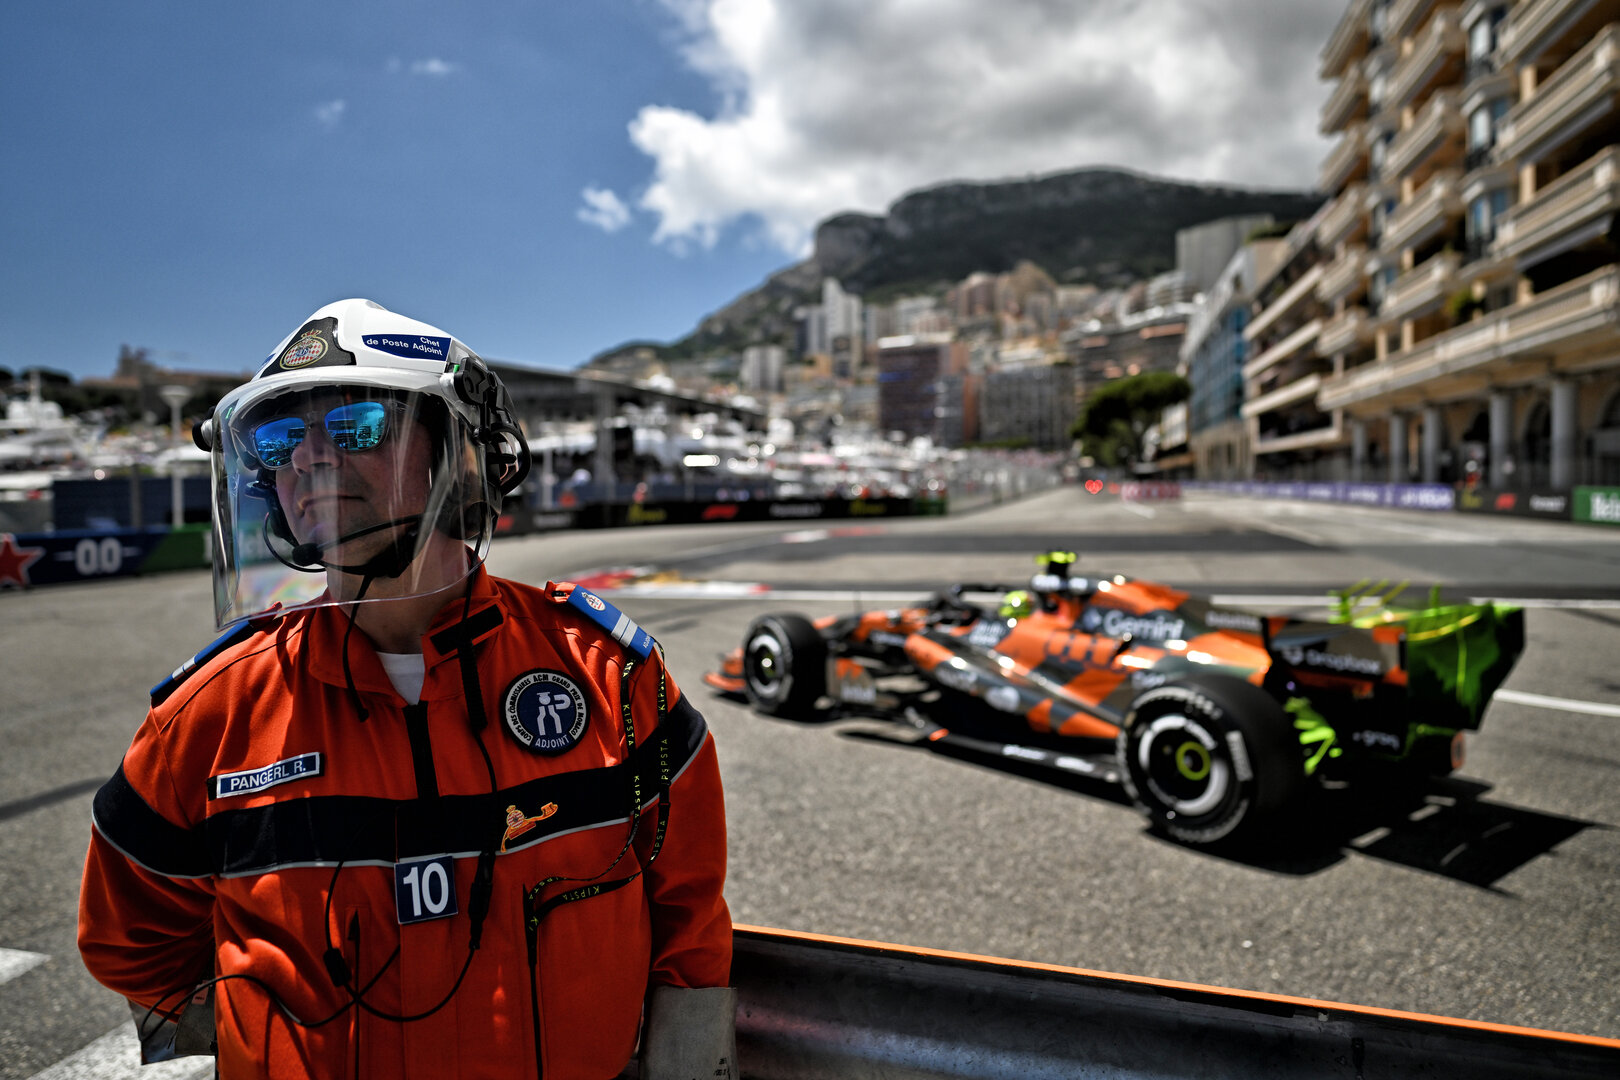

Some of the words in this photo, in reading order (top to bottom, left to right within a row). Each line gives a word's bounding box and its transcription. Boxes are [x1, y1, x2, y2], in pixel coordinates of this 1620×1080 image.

[366, 338, 379, 346] de
[382, 339, 409, 348] Poste
[412, 343, 443, 356] Adjoint
[420, 337, 440, 348] Chef
[1103, 609, 1185, 641] Gemini
[532, 674, 549, 682] ACM
[552, 675, 571, 689] GRAND
[570, 688, 581, 701] PRIX
[577, 702, 583, 710] DE
[622, 703, 634, 746] KIPSTA
[534, 734, 570, 749] ADJOINT
[230, 765, 290, 791] PANGERL
[293, 760, 306, 773] R.
[402, 861, 450, 917] 10
